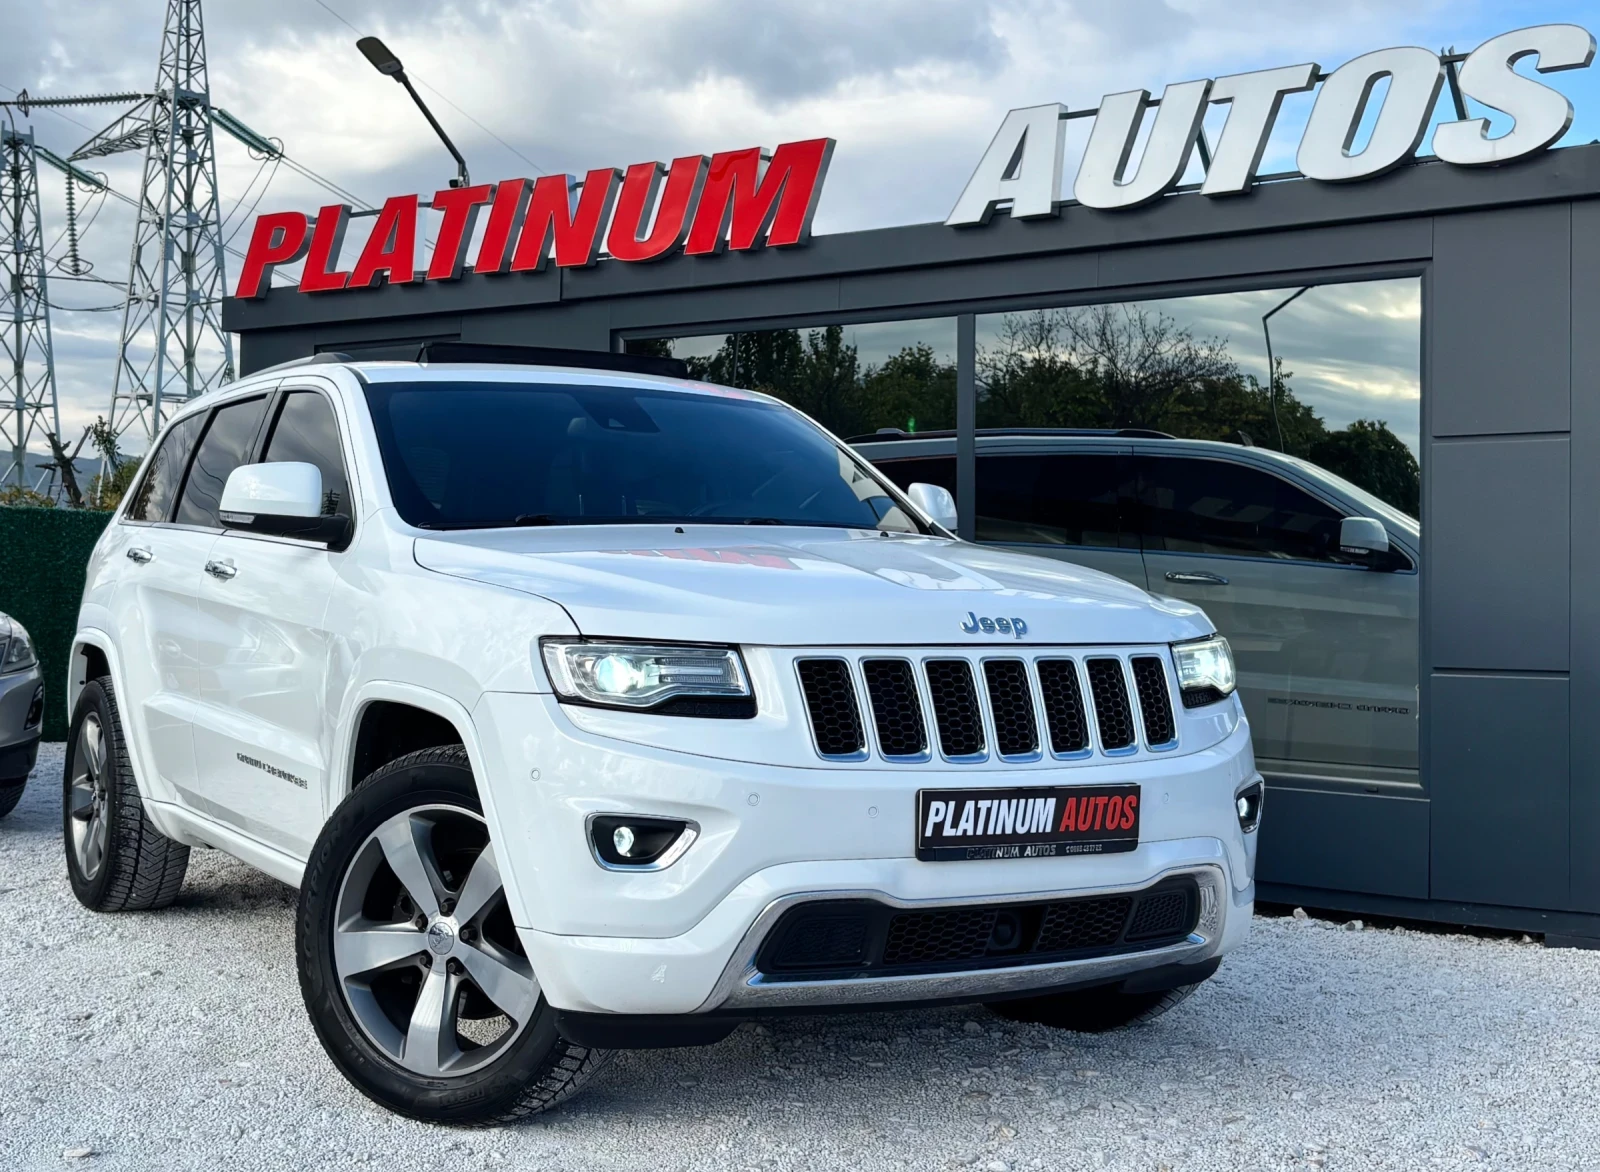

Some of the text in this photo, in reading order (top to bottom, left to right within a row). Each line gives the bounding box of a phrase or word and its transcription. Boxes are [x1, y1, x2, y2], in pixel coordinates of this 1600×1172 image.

[235, 23, 1597, 299] PLATINUM AUTOS
[960, 611, 1028, 640] Jeep
[924, 795, 1137, 837] PLATINUM AUTOS
[1024, 844, 1057, 857] AUTOS
